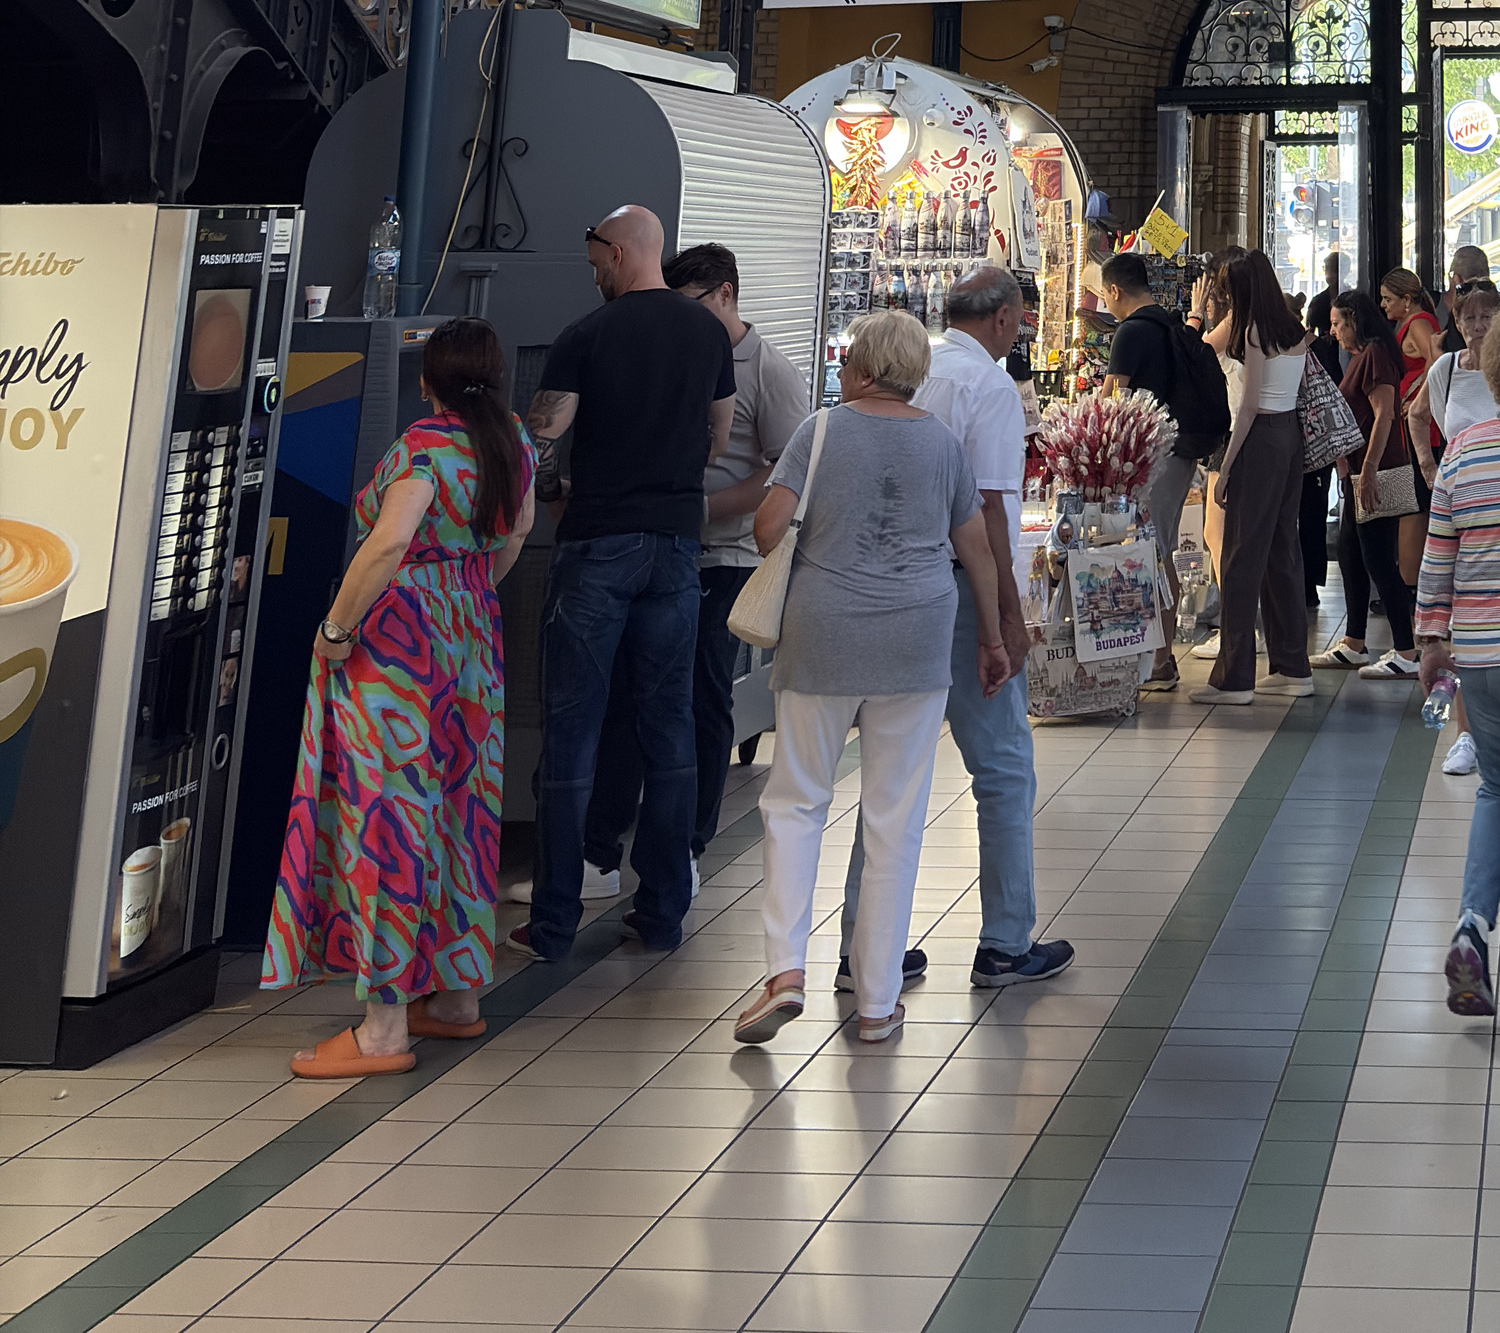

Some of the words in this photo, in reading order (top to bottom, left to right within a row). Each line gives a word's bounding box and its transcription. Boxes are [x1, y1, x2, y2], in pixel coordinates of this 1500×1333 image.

[1454, 118, 1491, 141] KING
[199, 254, 231, 265] PASSION
[231, 253, 244, 264] FOR
[243, 252, 263, 264] COFFEE
[1095, 631, 1146, 652] BUDAPEST
[1046, 646, 1075, 663] BUD
[131, 793, 164, 814] PASSION
[164, 789, 178, 805] FOR
